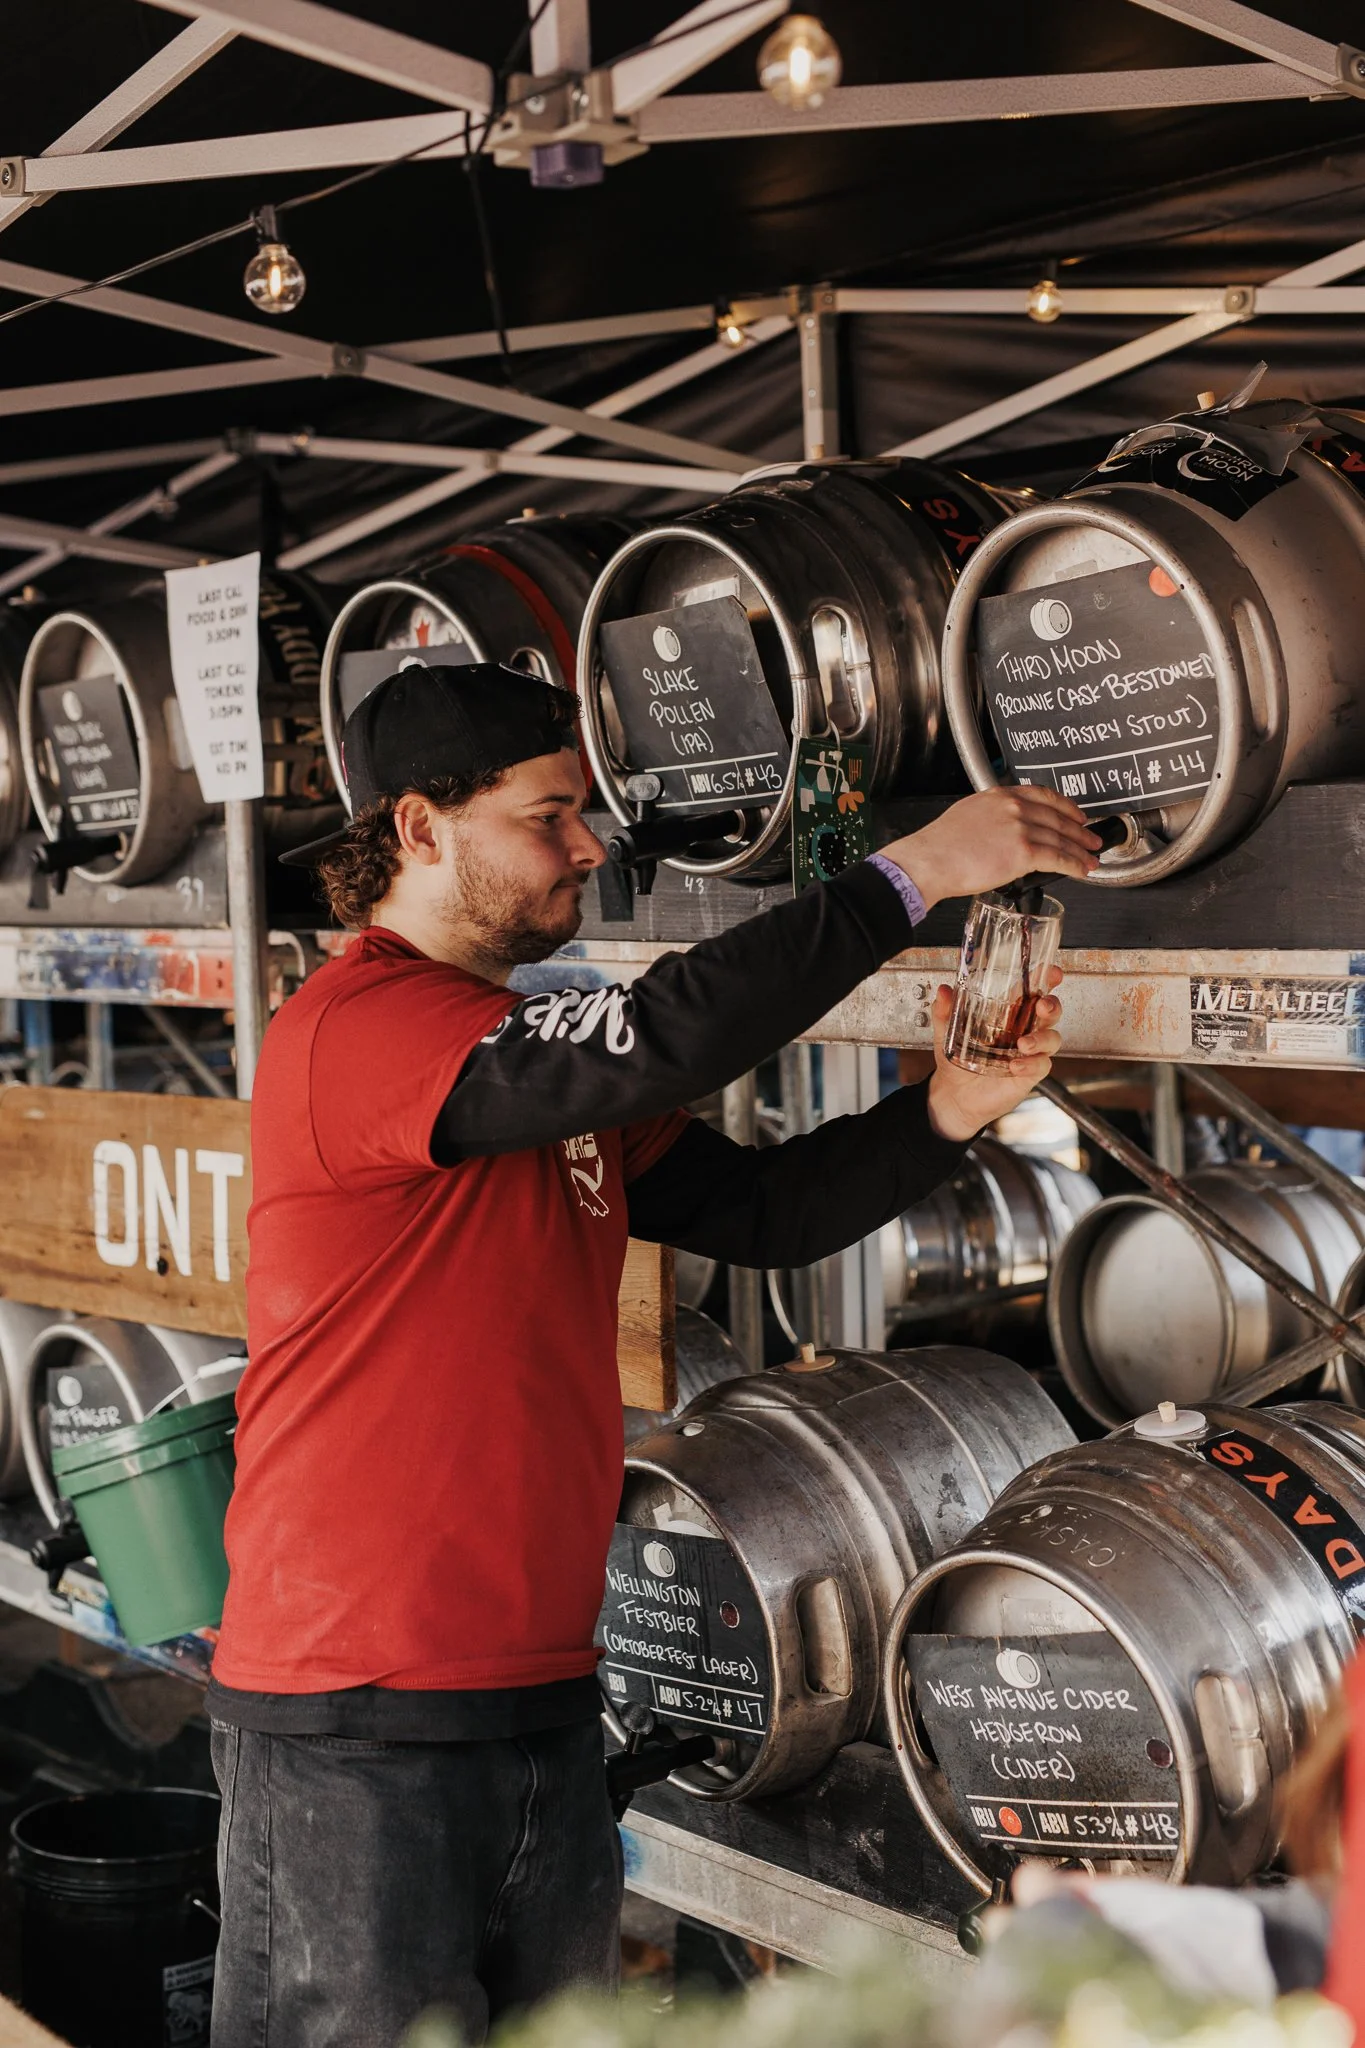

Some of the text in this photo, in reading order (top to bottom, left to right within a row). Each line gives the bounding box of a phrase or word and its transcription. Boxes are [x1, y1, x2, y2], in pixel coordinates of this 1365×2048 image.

[1198, 455, 1254, 482] MOON
[996, 639, 1121, 683] THIRD MOON
[643, 666, 699, 696] SLAKE
[649, 698, 715, 727] POLLEN
[995, 691, 1054, 718] BROWNIE
[1057, 683, 1102, 711] CASK
[1006, 693, 1208, 753] (IMPERIAL PASTRY STOUT)
[670, 726, 714, 756] (IPA)
[691, 774, 712, 794] ABV
[1061, 769, 1142, 797] ABV 11.9%
[685, 875, 704, 894] 43
[1211, 1441, 1365, 1580] DAYS
[606, 1567, 701, 1607] WELLINGTON
[617, 1600, 700, 1637] FESTBIER
[603, 1625, 759, 1685] (OKTOBERFEST LAGER)
[607, 1672, 627, 1693] IBU
[927, 1679, 1138, 1712] WEST AVENUE CIDER
[659, 1685, 722, 1716] ABV 5.2%
[969, 1718, 1083, 1745] HEDGEROW
[990, 1750, 1076, 1783] (CIDER)
[970, 1806, 997, 1829] IBU
[1038, 1811, 1071, 1835] ABV
